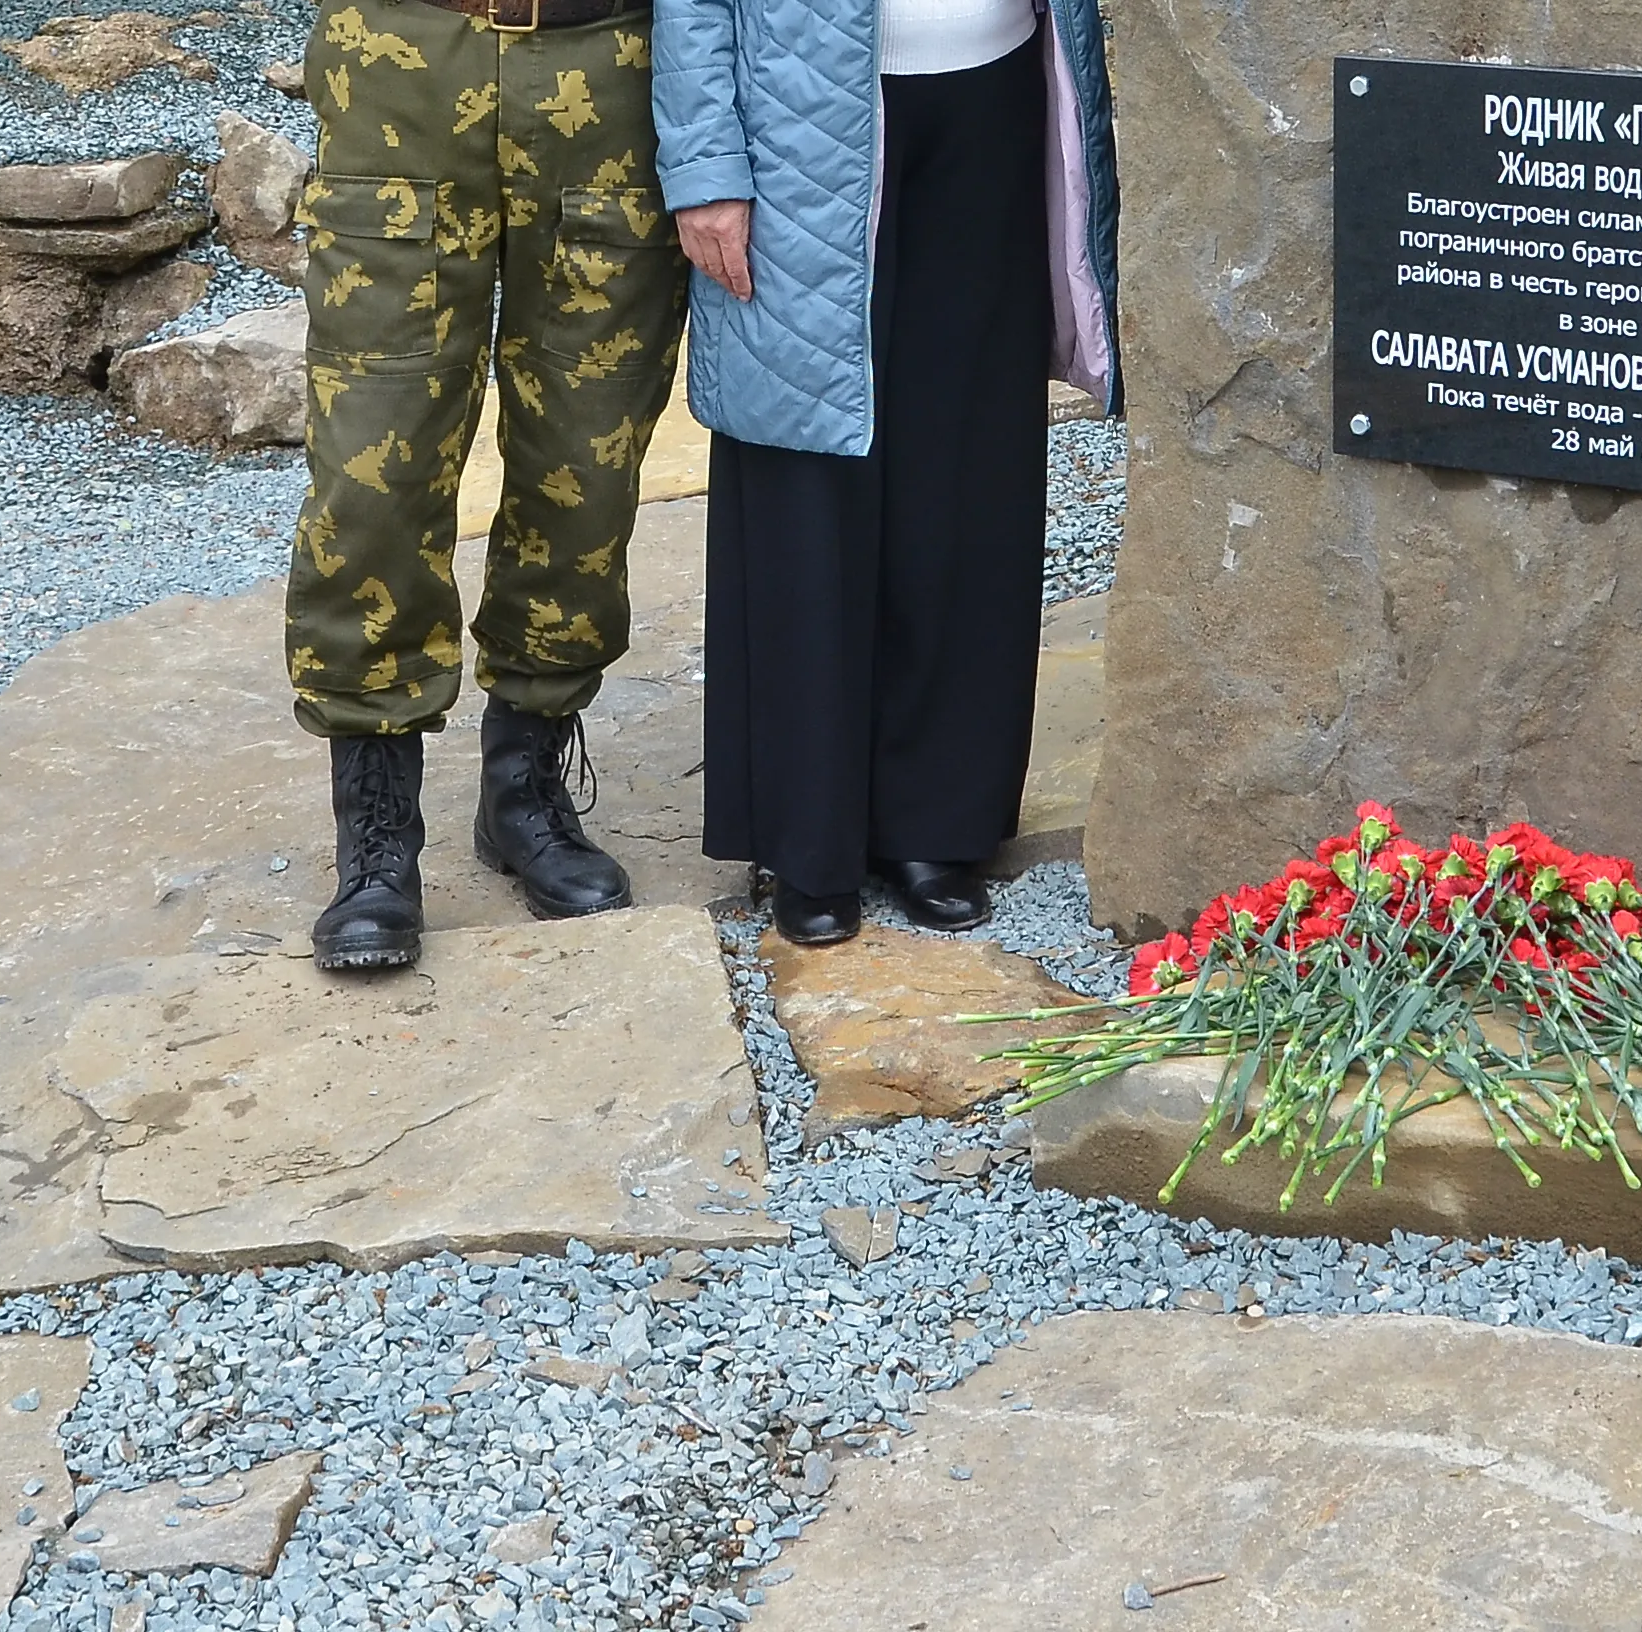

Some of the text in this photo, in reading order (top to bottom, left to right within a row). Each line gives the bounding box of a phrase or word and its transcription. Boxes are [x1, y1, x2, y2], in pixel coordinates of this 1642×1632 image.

[1484, 93, 1605, 147] РОДНИК
[1497, 150, 1585, 191] Живая
[1407, 191, 1570, 227] Благоустроен
[1399, 230, 1565, 261] пограничного
[1397, 260, 1481, 288] района
[1489, 272, 1504, 290] в
[1510, 274, 1578, 296] честь
[1559, 313, 1574, 331] в
[1579, 315, 1638, 337] зоне
[1371, 329, 1510, 378] САЛАВАТА
[1427, 382, 1485, 409] Пока
[1491, 392, 1561, 416] течёт
[1567, 401, 1624, 426] вода
[1551, 428, 1581, 452] 28
[1588, 434, 1634, 458] май
